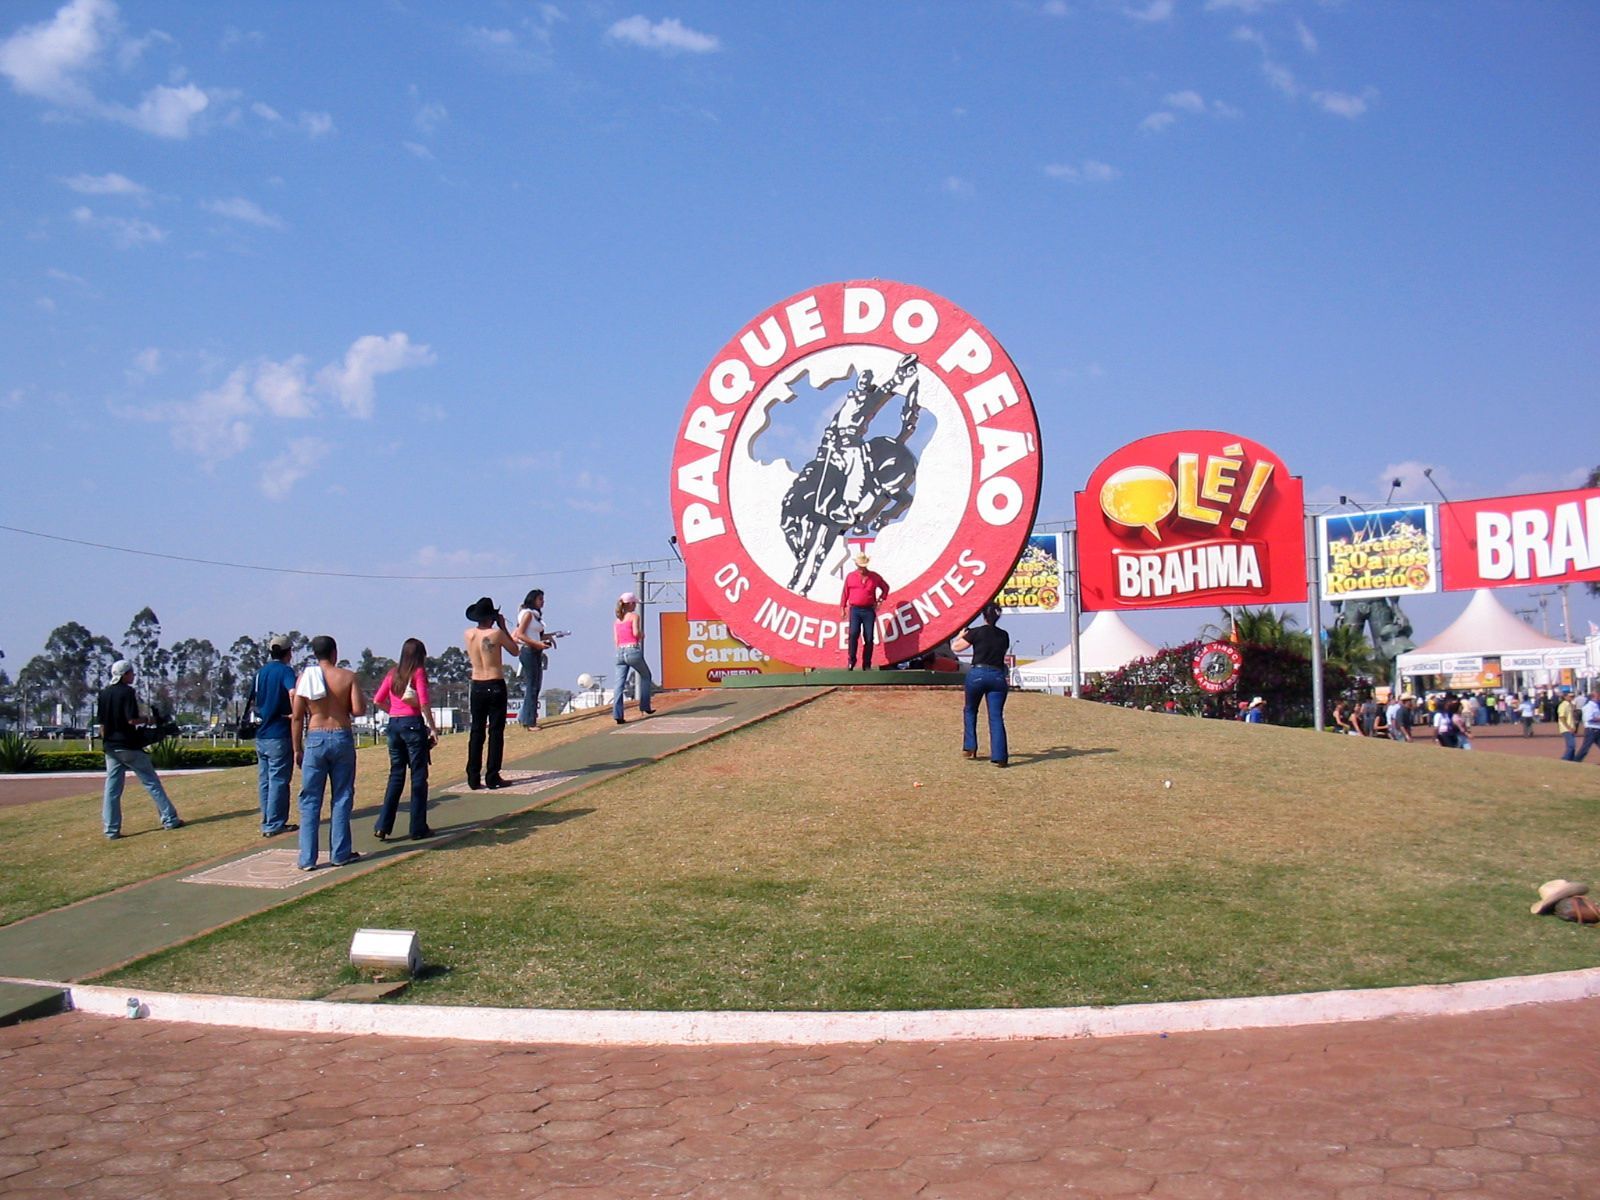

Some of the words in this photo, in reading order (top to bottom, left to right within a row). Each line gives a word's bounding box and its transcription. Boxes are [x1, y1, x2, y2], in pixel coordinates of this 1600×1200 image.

[678, 295, 827, 544] PARQUE
[843, 287, 939, 345] DO
[936, 328, 1037, 527] PEÃO
[1329, 538, 1413, 556] Barretos
[714, 562, 751, 604] OS
[1118, 544, 1263, 598] BRAHMA
[1326, 570, 1408, 595] Rodeio
[687, 620, 728, 641] Eu
[686, 644, 770, 663] Carne.
